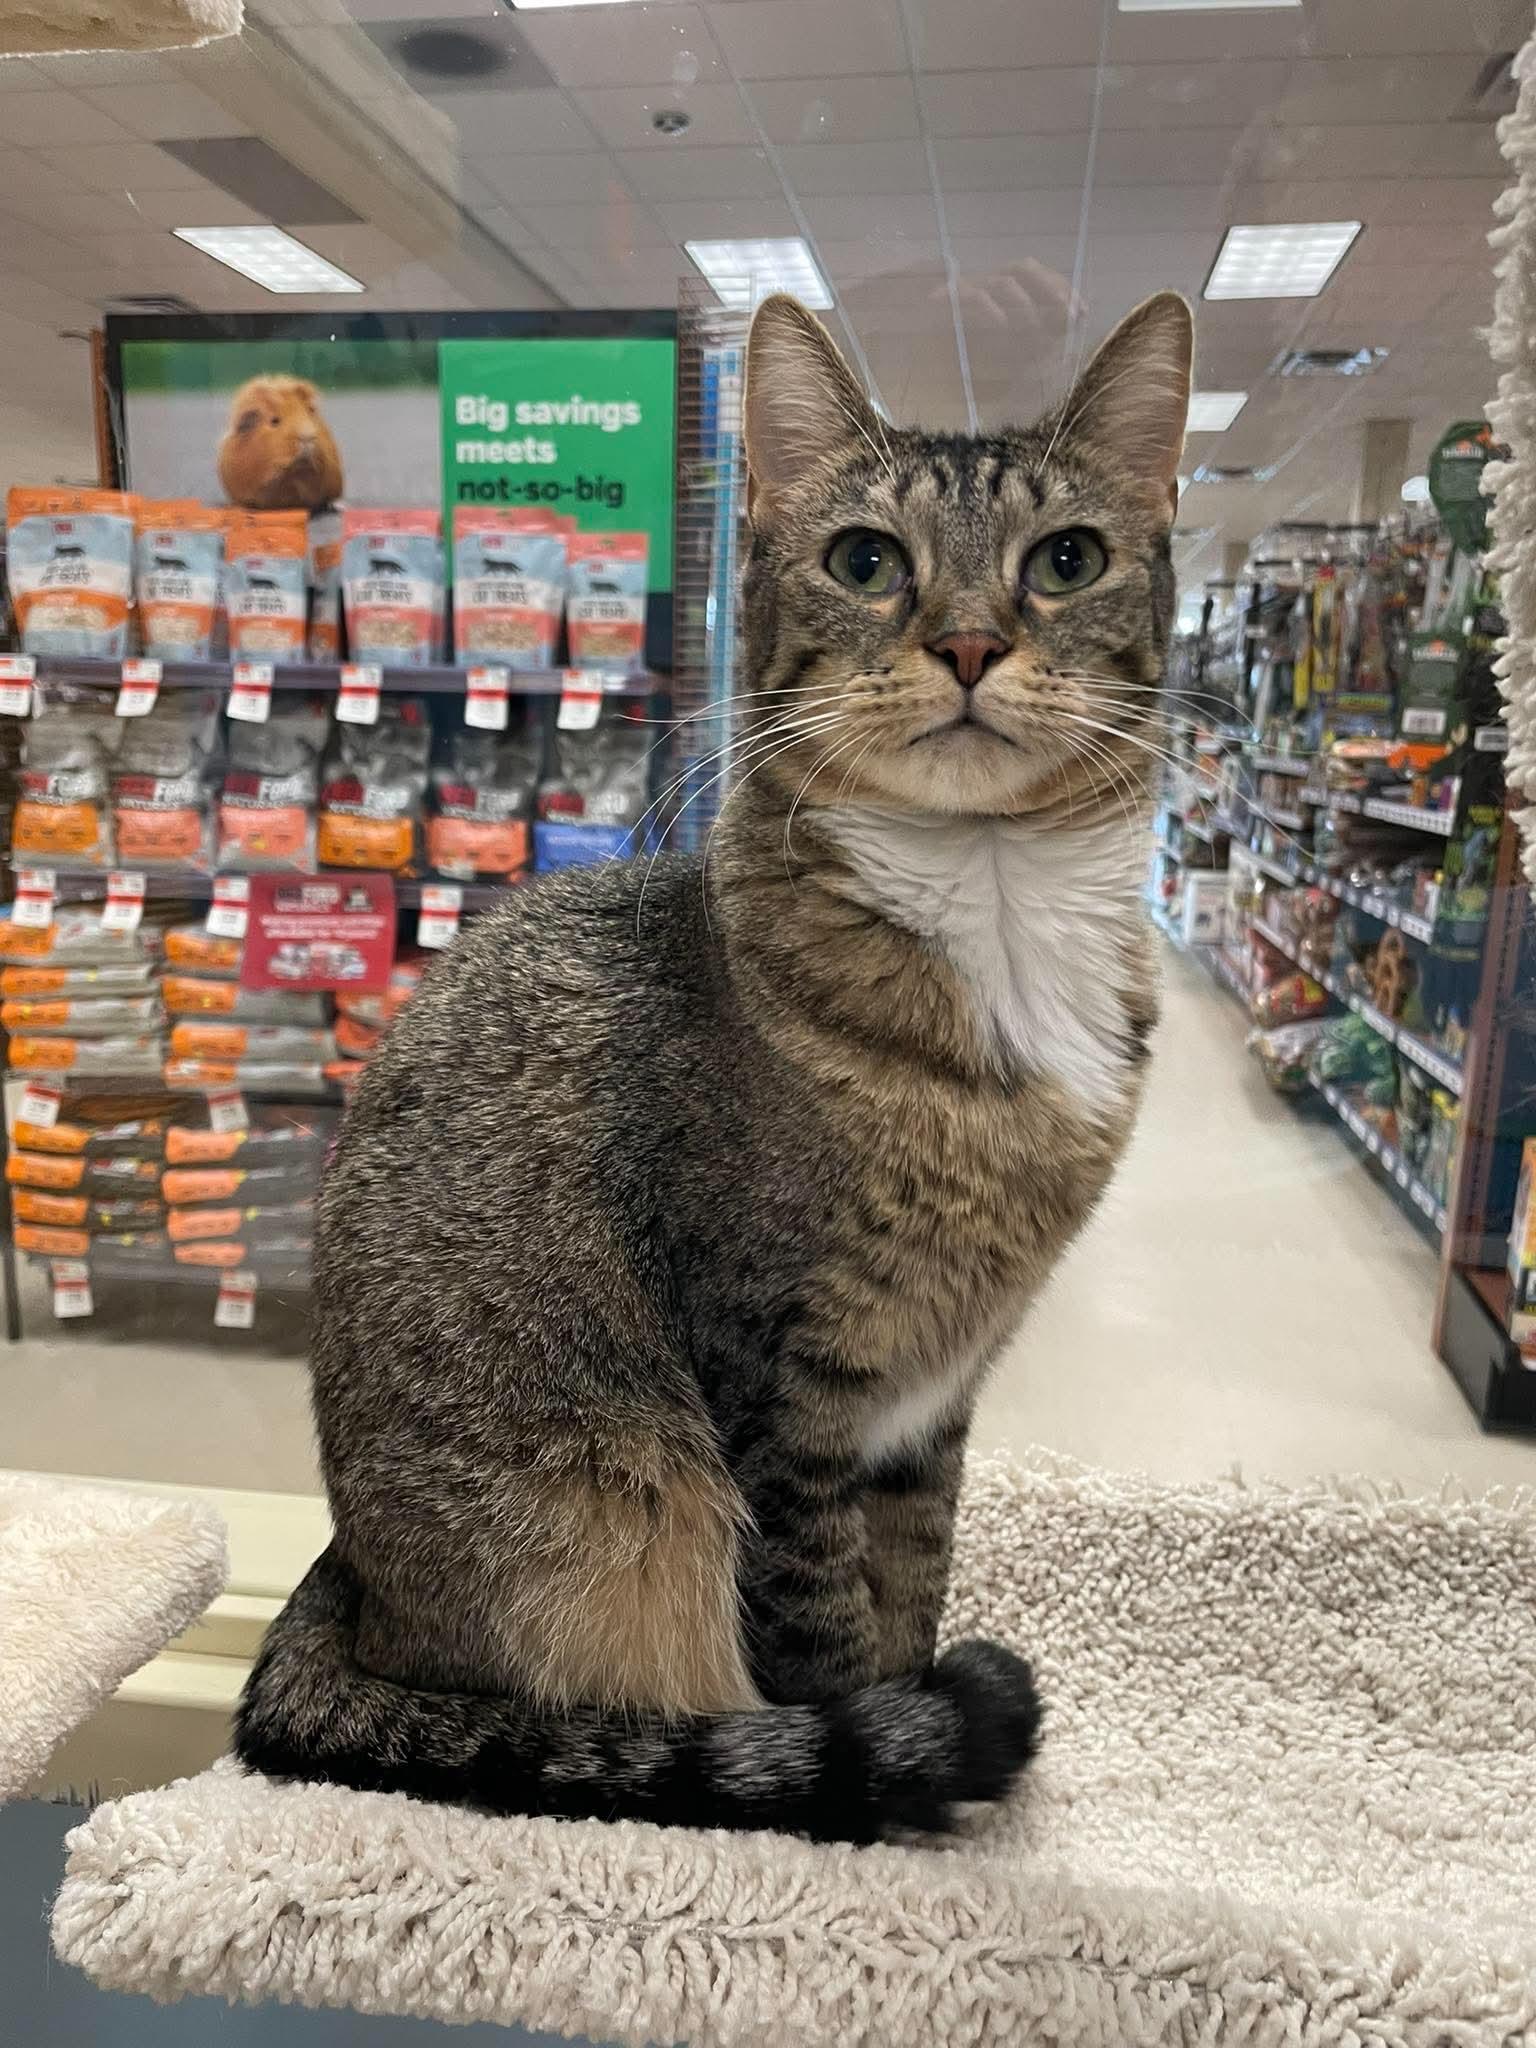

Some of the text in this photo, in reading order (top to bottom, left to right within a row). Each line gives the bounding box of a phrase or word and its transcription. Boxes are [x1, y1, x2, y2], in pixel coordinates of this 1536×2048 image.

[456, 395, 642, 432] Big savings
[456, 436, 557, 464] meets
[458, 475, 624, 508] not-so-big
